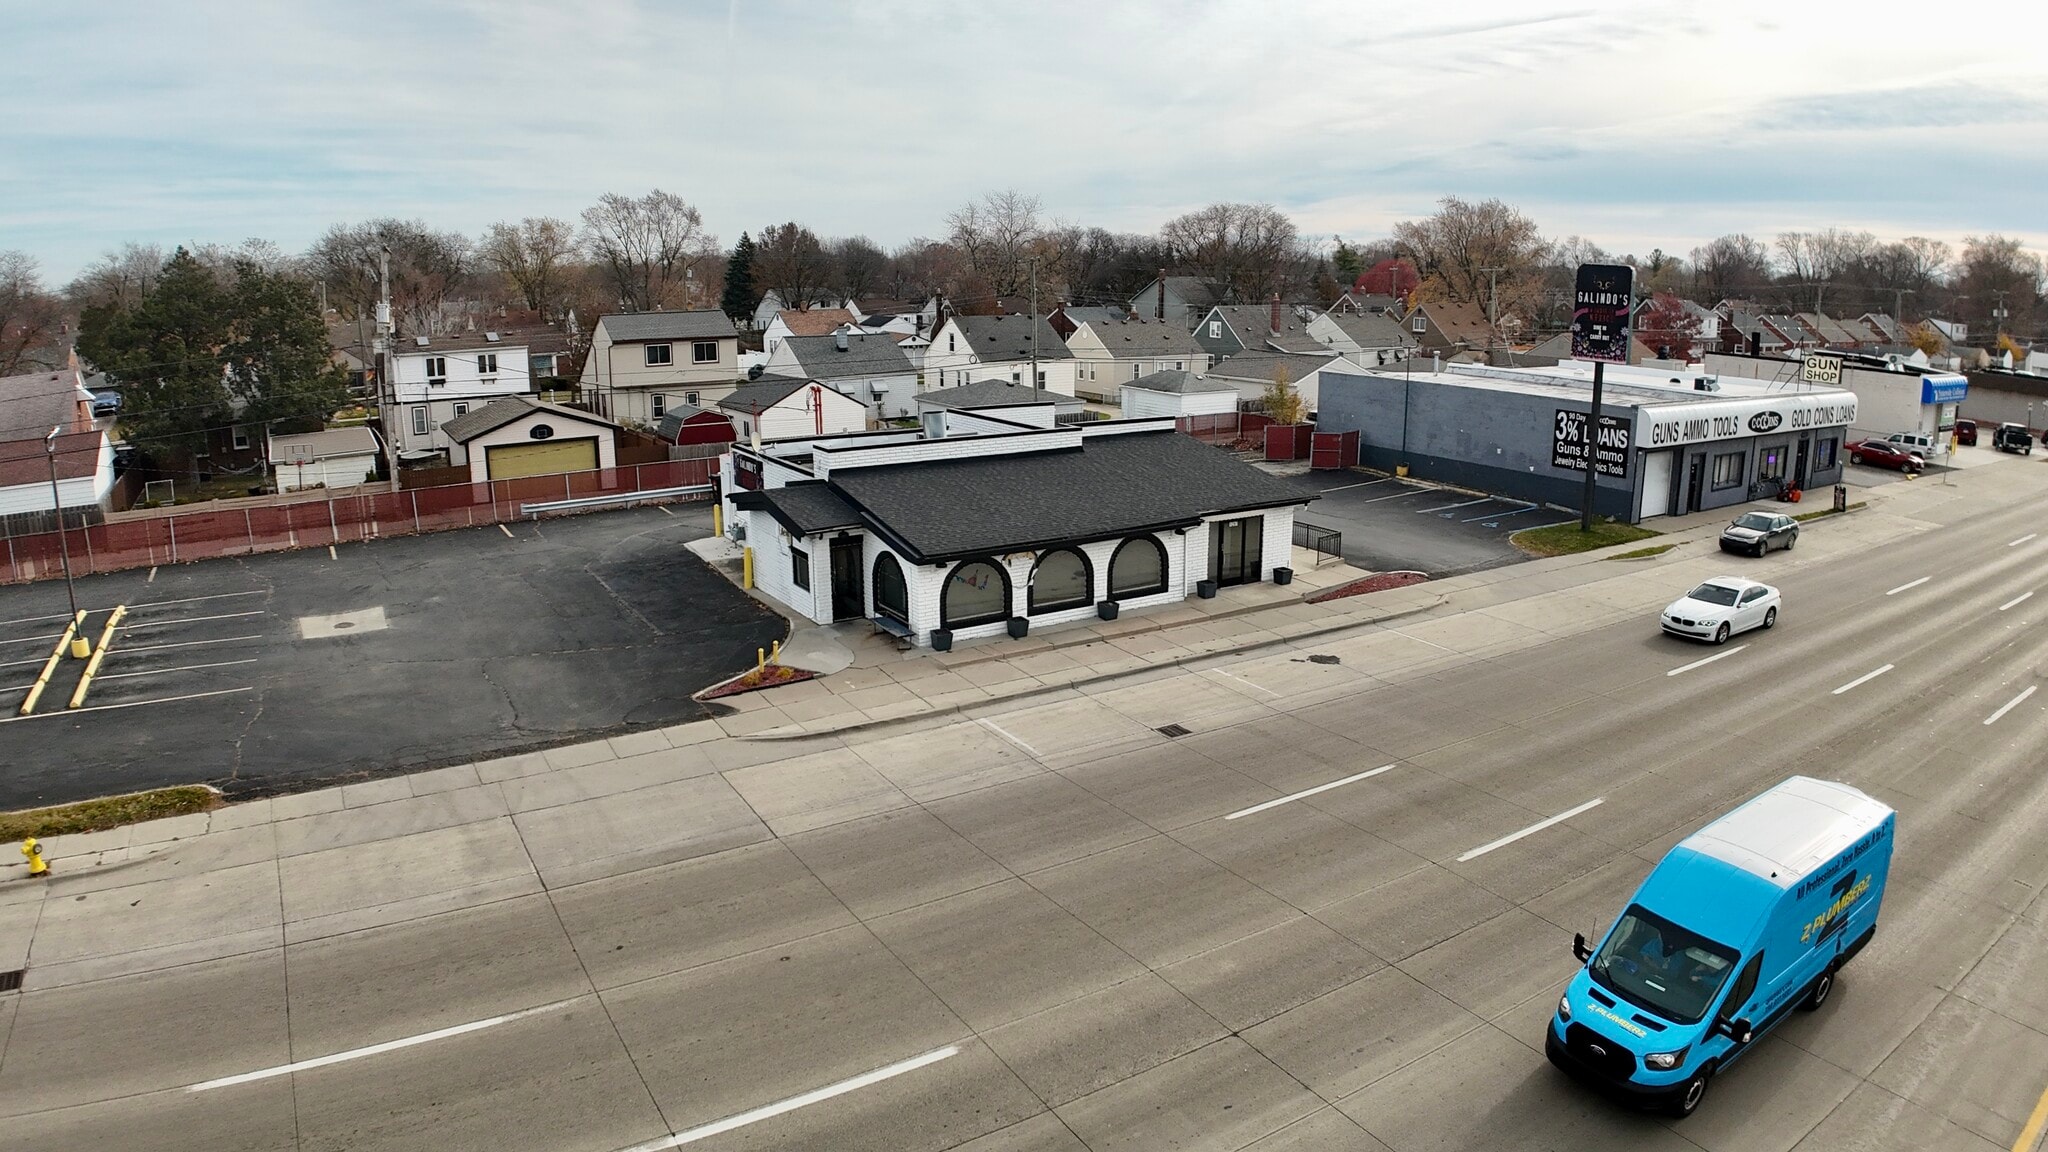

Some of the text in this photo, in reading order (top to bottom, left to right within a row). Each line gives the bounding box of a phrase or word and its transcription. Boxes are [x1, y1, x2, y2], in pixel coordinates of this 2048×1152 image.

[1578, 291, 1628, 306] GALINDO'S
[1807, 358, 1839, 371] GUN
[1806, 370, 1837, 381] SHOP
[1576, 413, 1586, 423] Day
[1792, 404, 1855, 428] GOLD COINS LOANS
[1555, 411, 1628, 449] 3% LANS
[1652, 415, 1739, 444] GUNS AMMO TOOLS
[1556, 441, 1581, 456] Guns
[1583, 445, 1590, 457] &
[1608, 463, 1624, 475] Tools
[1812, 873, 1872, 933] PLUMBERZ
[1596, 1007, 1648, 1038] PLUMBERZ
